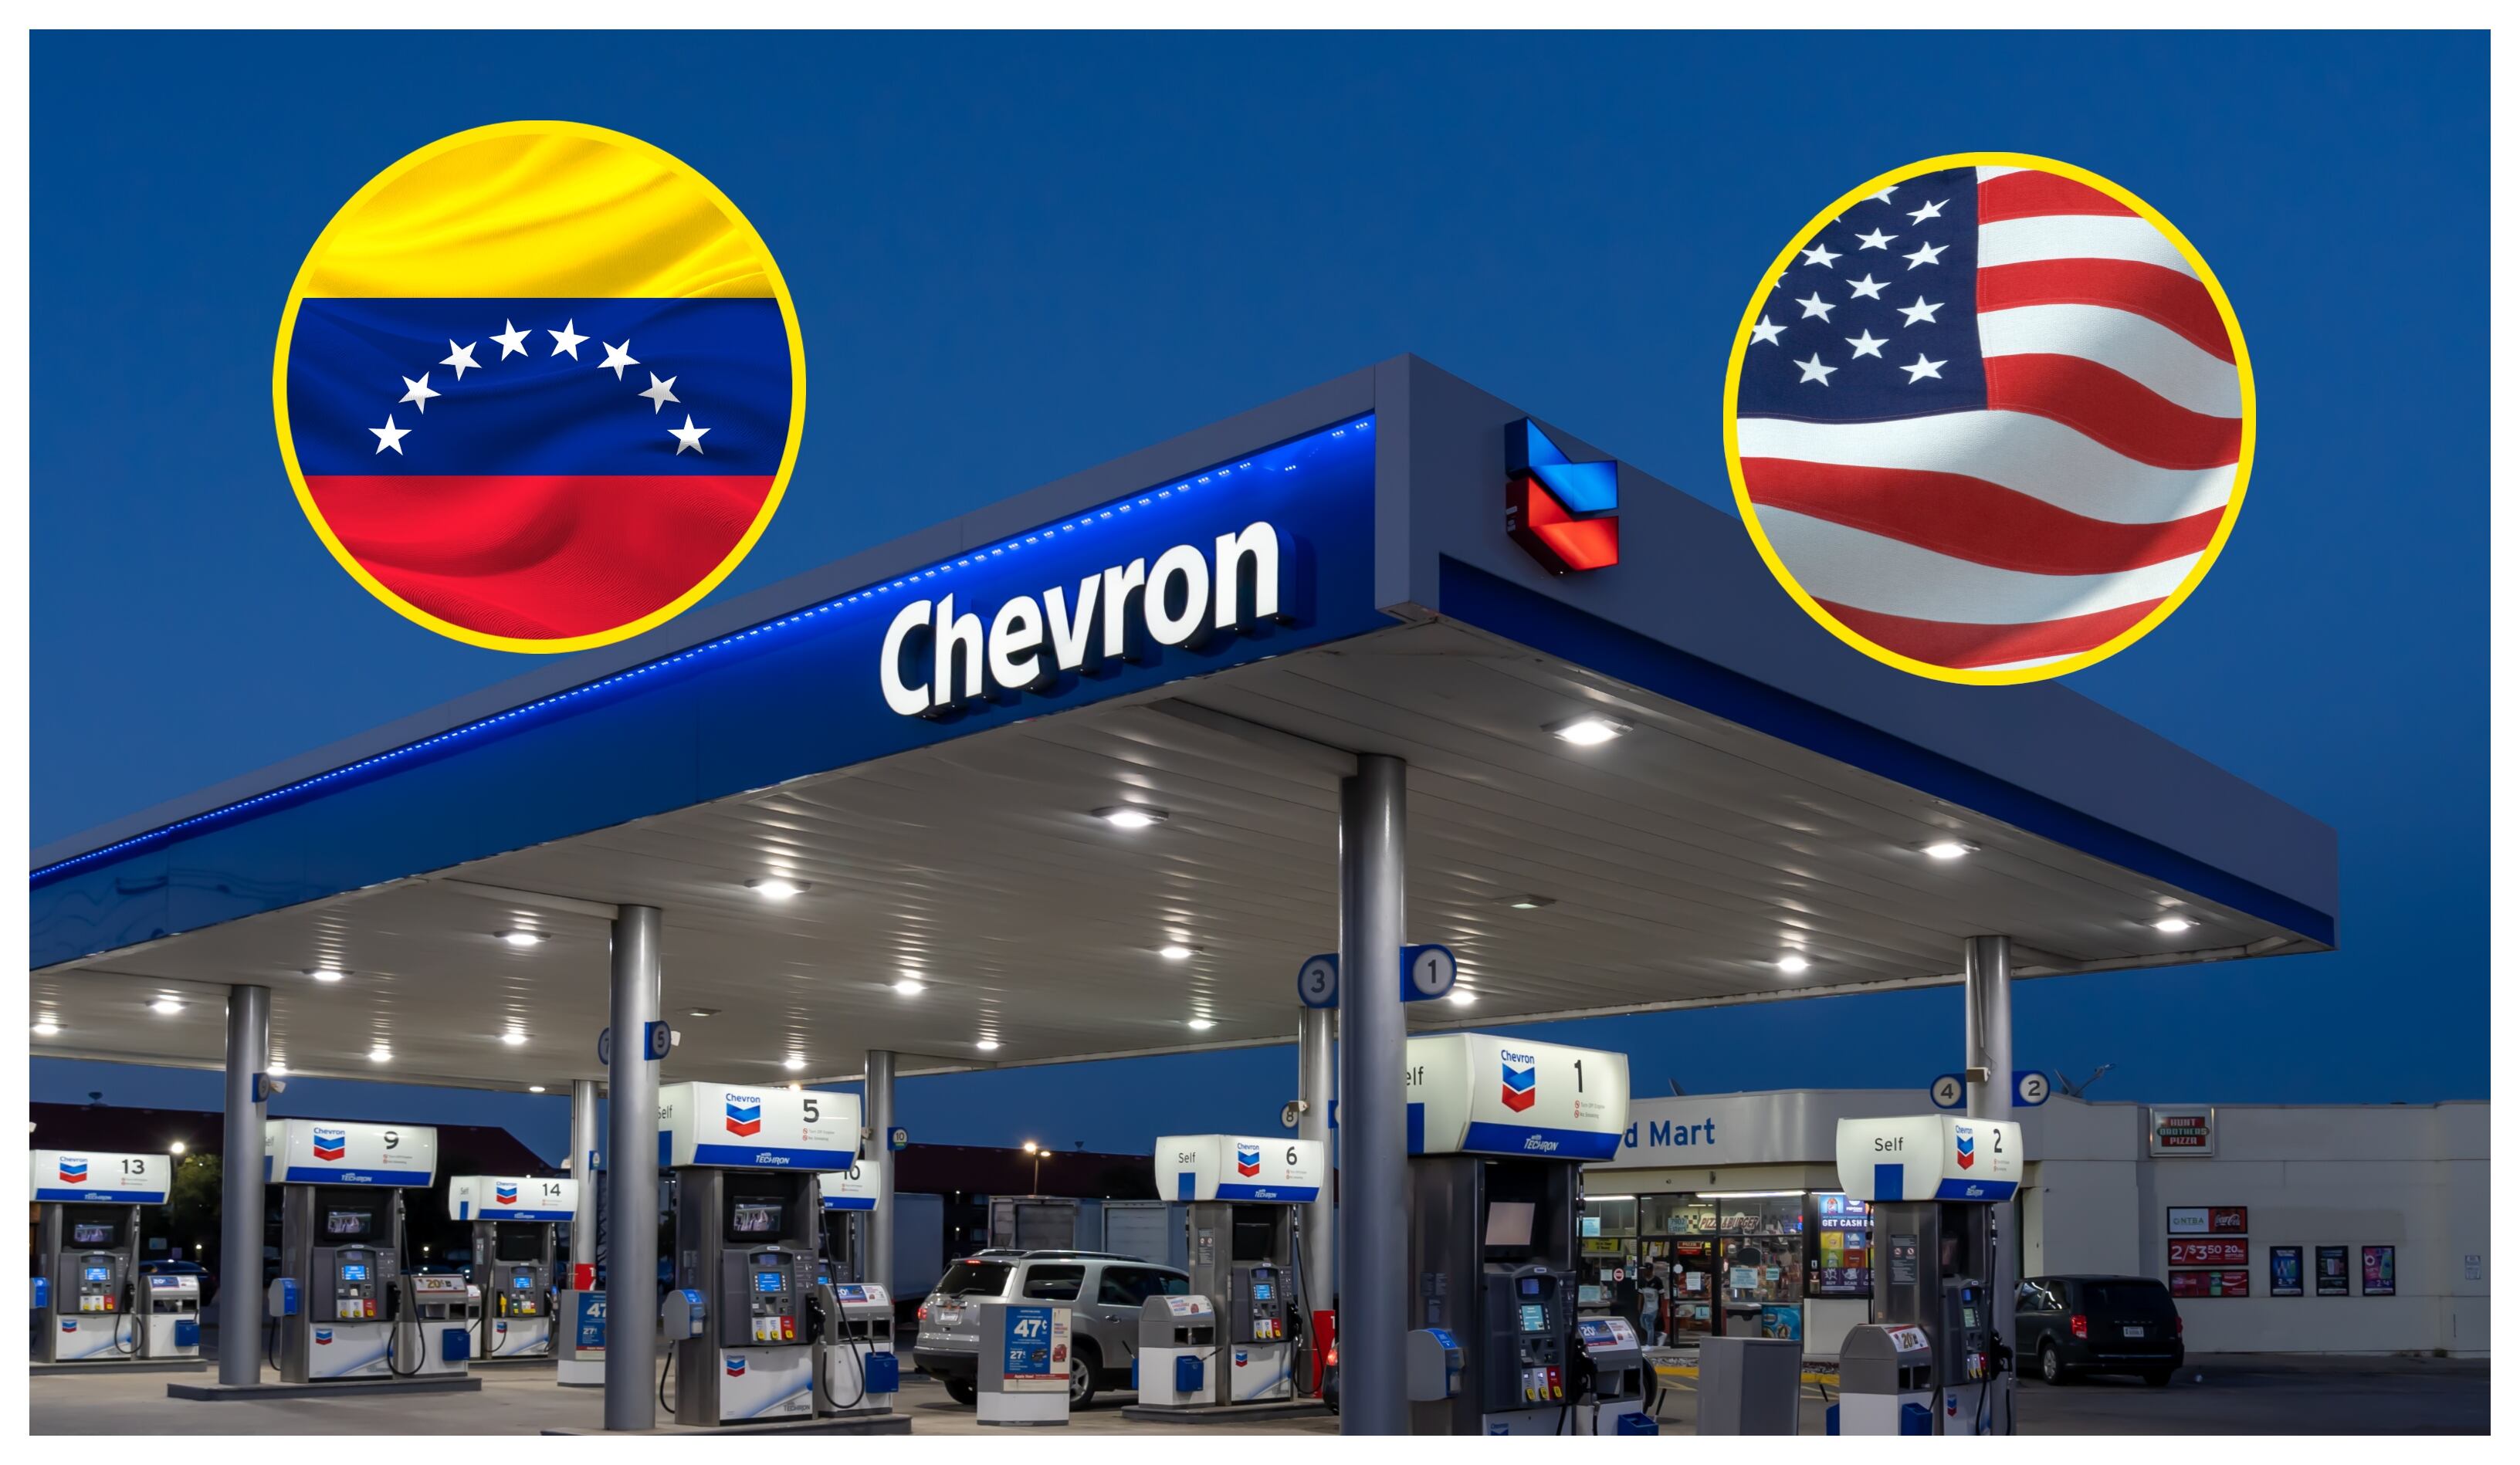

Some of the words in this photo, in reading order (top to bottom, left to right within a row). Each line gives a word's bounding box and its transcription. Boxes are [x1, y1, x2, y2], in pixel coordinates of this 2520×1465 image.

[879, 520, 1279, 716] Chevron
[1428, 959, 1437, 984] 1
[1310, 969, 1326, 993] 3
[658, 1030, 666, 1048] 5
[1500, 1049, 1536, 1065] Chevron
[1407, 1066, 1424, 1086] elf
[1573, 1059, 1583, 1093] 1
[1940, 1083, 1954, 1099] 4
[2027, 1080, 2041, 1097] 2
[725, 1093, 761, 1104] Chevron
[803, 1098, 820, 1123] 5
[1285, 1109, 1294, 1123] 8
[1955, 1124, 1973, 1135] Chevron
[2170, 1118, 2196, 1126] HUNT
[313, 1127, 346, 1136] Chevron
[896, 1132, 905, 1142] 10
[1649, 1117, 1716, 1147] Mart
[2159, 1127, 2207, 1135] BROTHERS
[383, 1130, 400, 1150] 9
[1237, 1142, 1260, 1151] Chevron
[1523, 1139, 1560, 1153] TECHRON
[1874, 1136, 1904, 1152] Self
[1993, 1128, 2003, 1153] 2
[2169, 1136, 2197, 1145] PIZZA
[755, 1155, 790, 1165] TECHRON
[1178, 1151, 1197, 1164] Self
[1286, 1145, 1298, 1166] 6
[121, 1159, 145, 1175] 13
[542, 1182, 561, 1196] 14
[1255, 1191, 1278, 1199] TECHRON
[1699, 1217, 1716, 1229] PIZZ
[1822, 1219, 1838, 1227] GET
[1840, 1219, 1862, 1227] CASH
